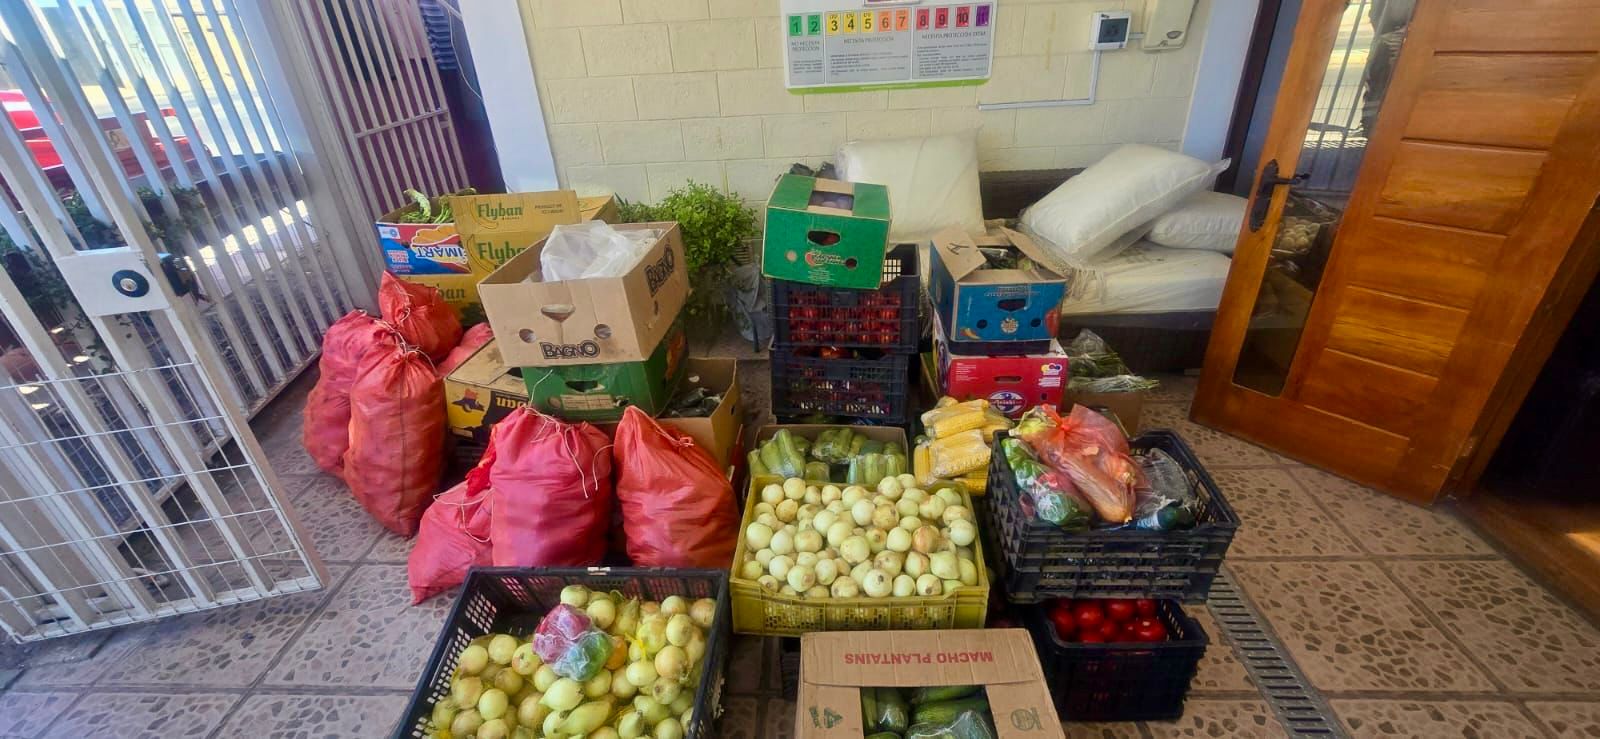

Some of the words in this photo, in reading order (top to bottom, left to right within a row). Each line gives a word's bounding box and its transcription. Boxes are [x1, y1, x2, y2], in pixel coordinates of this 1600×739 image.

[811, 21, 818, 32] 2
[831, 20, 838, 31] 3
[847, 19, 854, 30] 4
[864, 18, 872, 29] 5
[881, 17, 889, 28] 6
[899, 16, 906, 27] 7
[920, 15, 926, 26] 8
[939, 14, 946, 25] 9
[956, 13, 969, 23] 10
[477, 202, 523, 220] Flyban
[644, 244, 675, 297] BAGNO
[539, 339, 600, 359] BAGNO
[845, 652, 931, 665] PLANTAINS
[937, 651, 992, 664] MACHO
